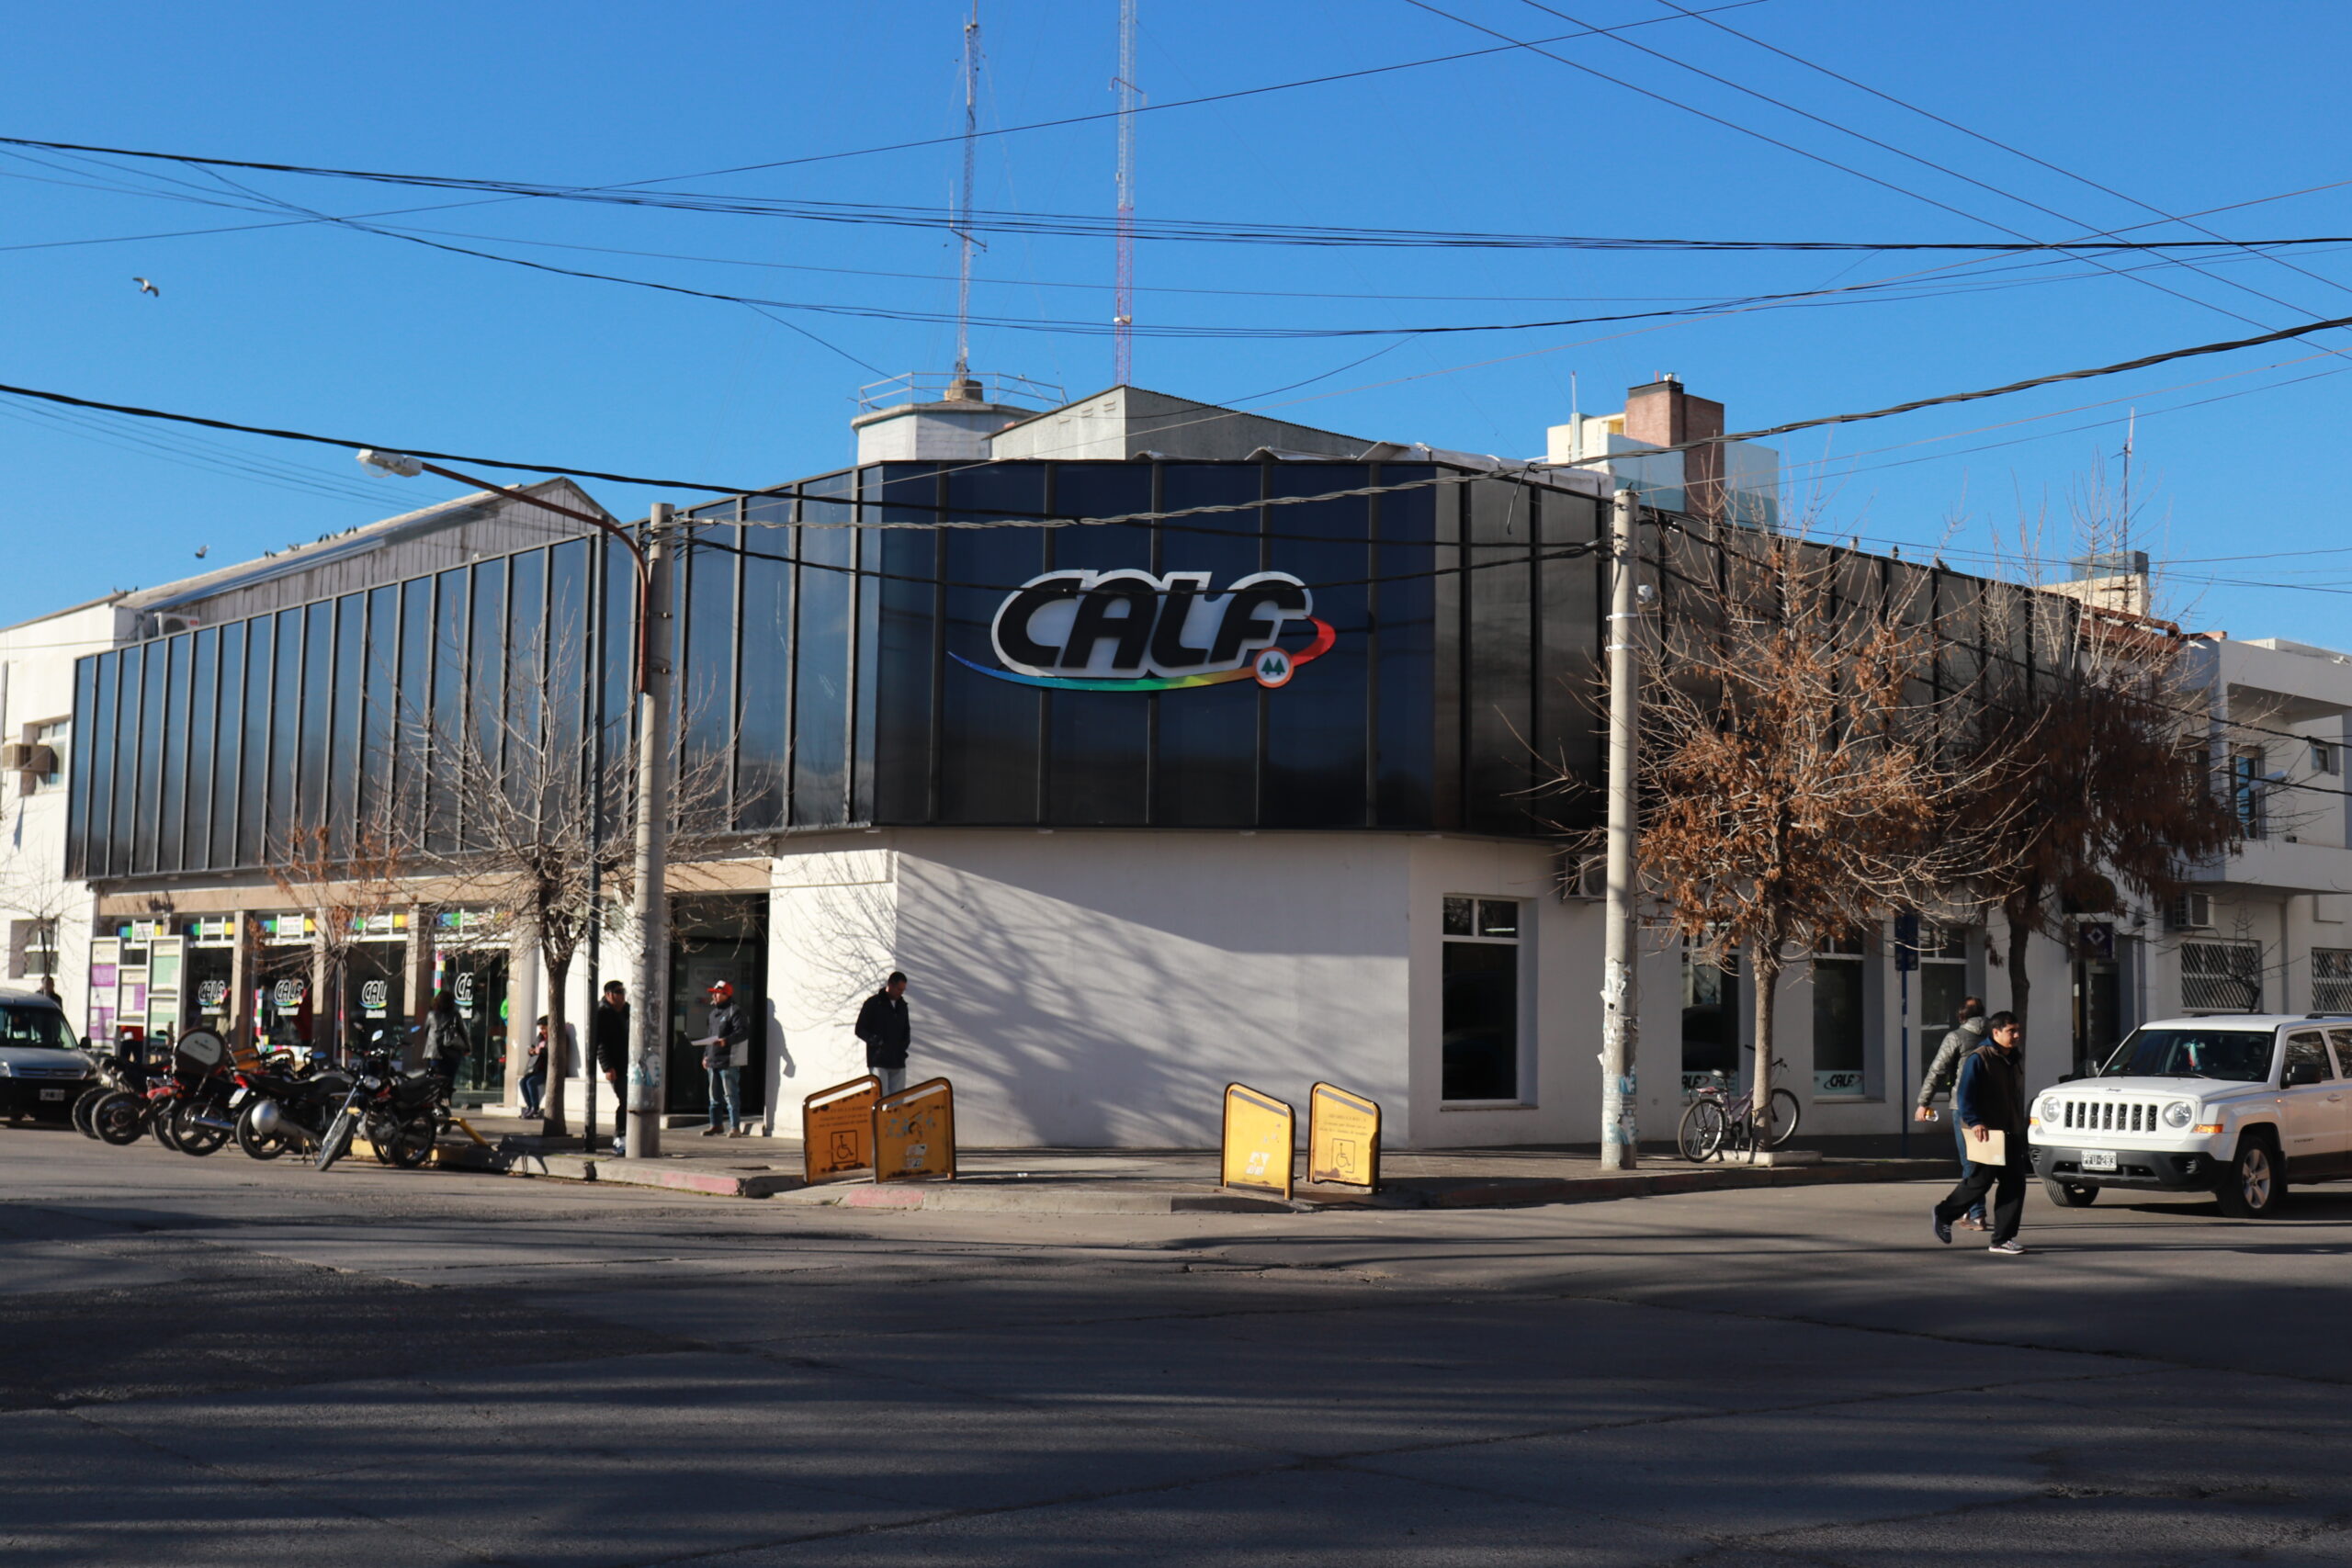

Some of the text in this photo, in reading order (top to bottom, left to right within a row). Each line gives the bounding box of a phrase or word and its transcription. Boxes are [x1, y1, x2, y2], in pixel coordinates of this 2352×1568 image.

[993, 571, 1312, 676] CALF
[274, 979, 304, 1002] CALF
[362, 980, 388, 1004] CAL
[1681, 1075, 1702, 1089] ALF
[1829, 1073, 1856, 1089] CALF
